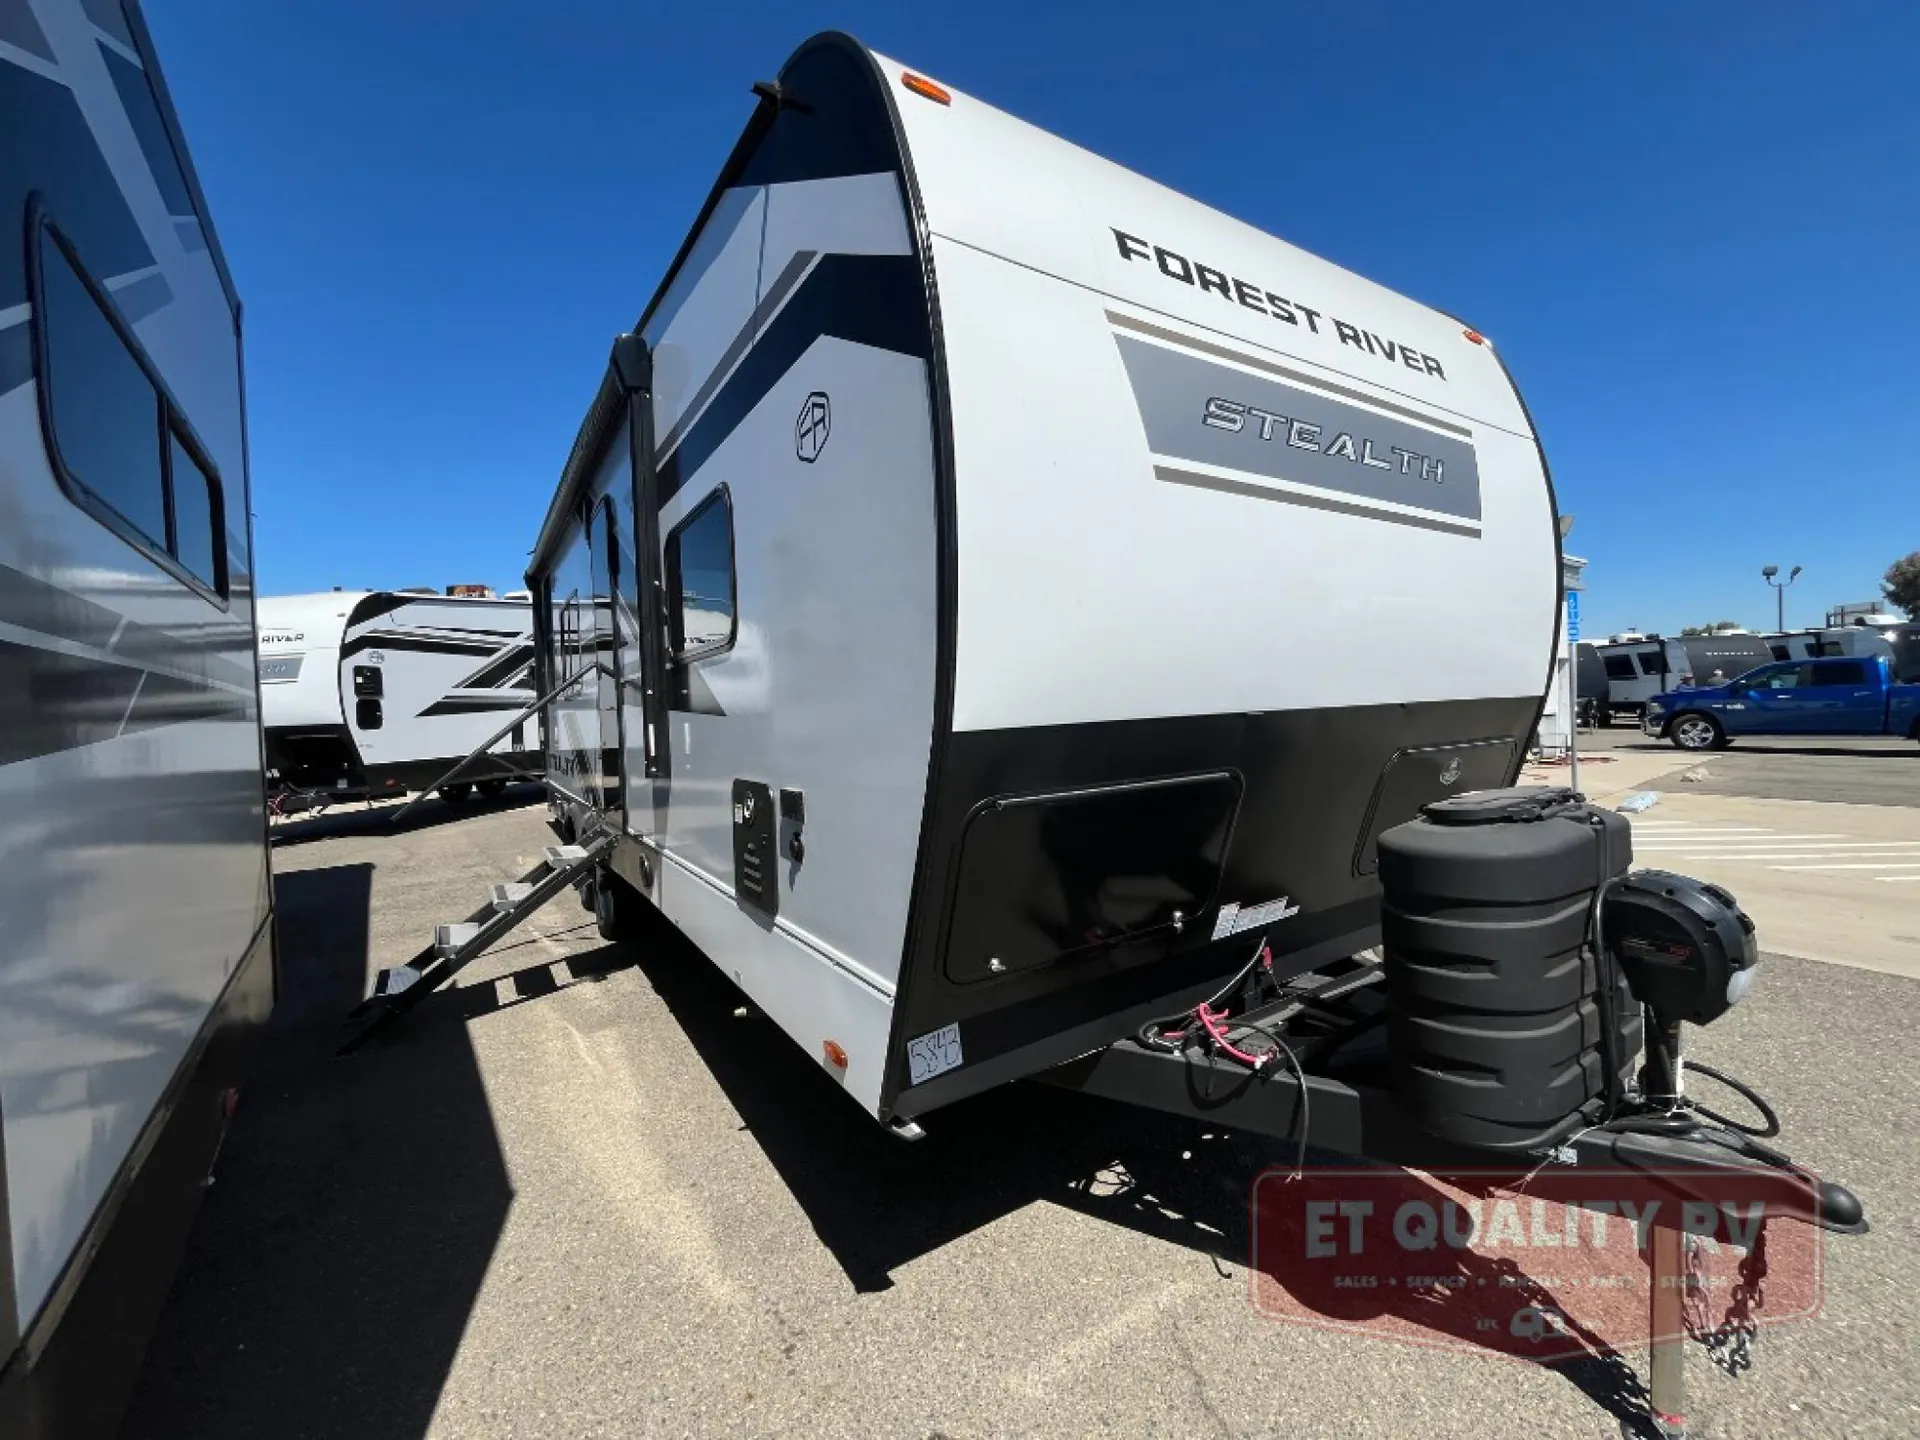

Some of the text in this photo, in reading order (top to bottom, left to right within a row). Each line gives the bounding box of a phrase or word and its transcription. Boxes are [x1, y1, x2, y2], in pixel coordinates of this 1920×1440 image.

[1110, 226, 1447, 382] FOREST RIVER
[1201, 396, 1445, 484] STEALTH
